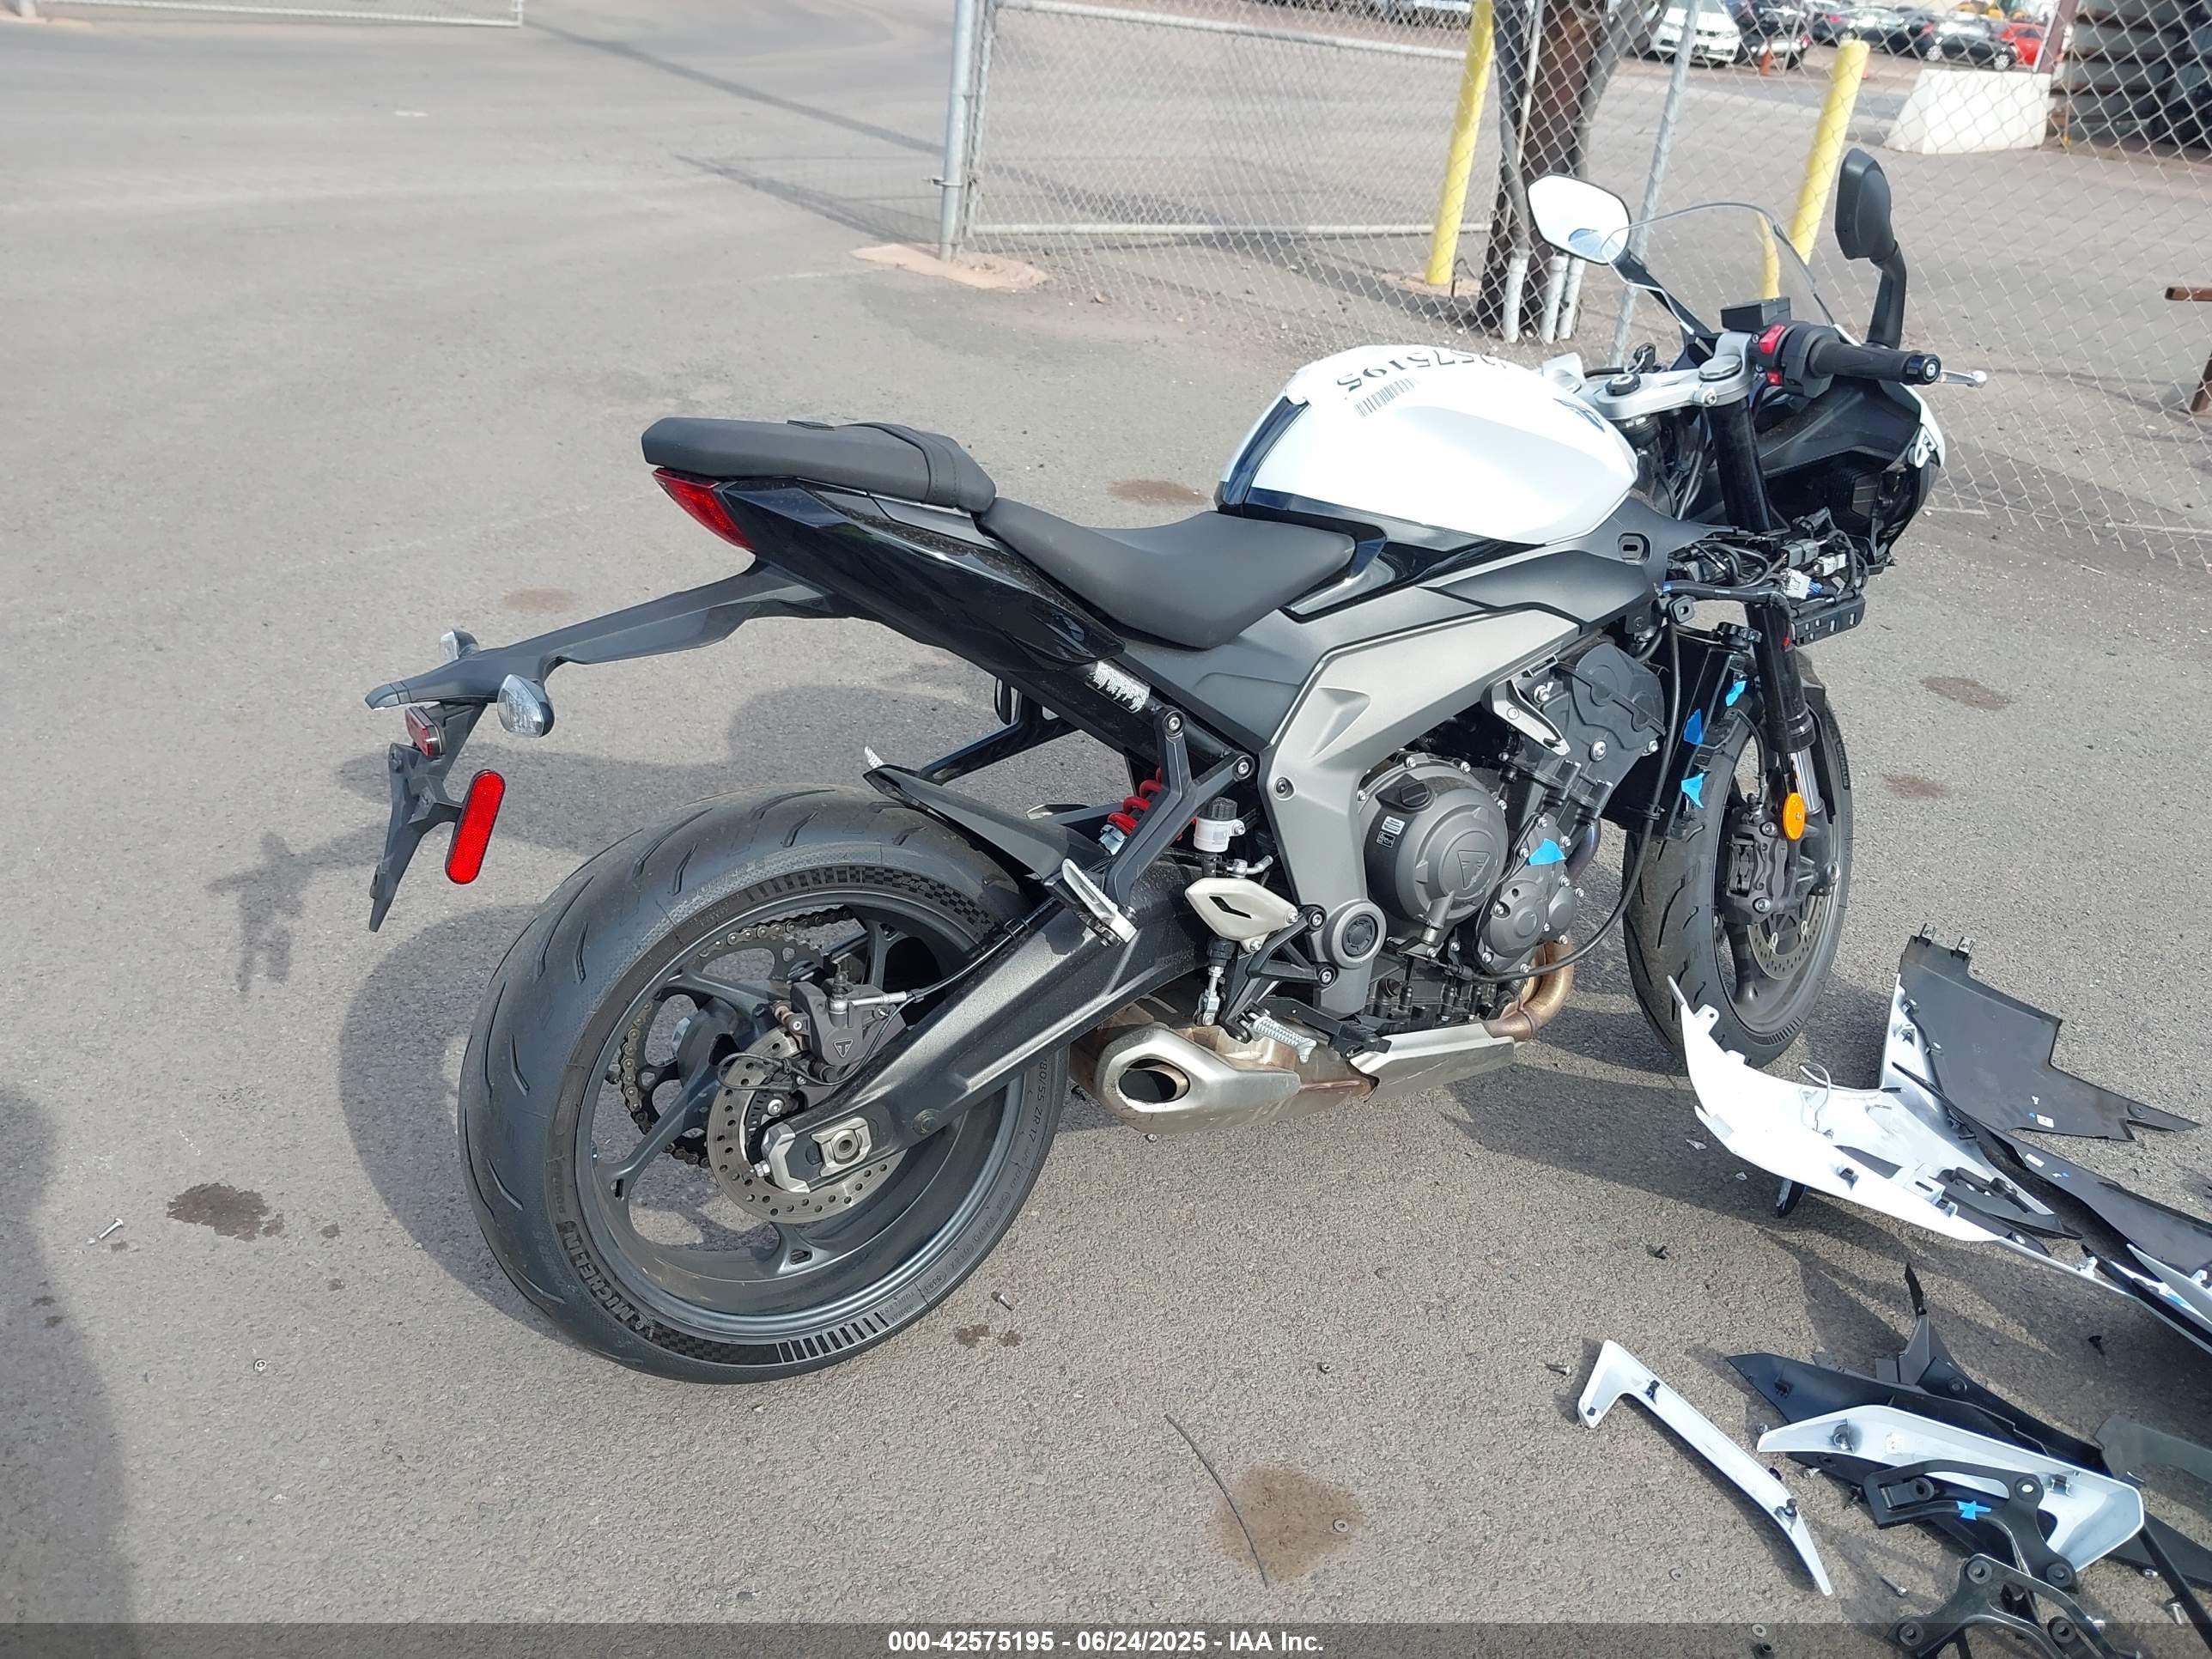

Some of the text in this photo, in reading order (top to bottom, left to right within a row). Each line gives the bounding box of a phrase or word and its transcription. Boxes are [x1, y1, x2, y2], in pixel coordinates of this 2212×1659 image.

[1033, 1106, 1043, 1125] ZR
[1029, 1128, 1037, 1143] 17
[563, 1231, 635, 1321] MICHELIN
